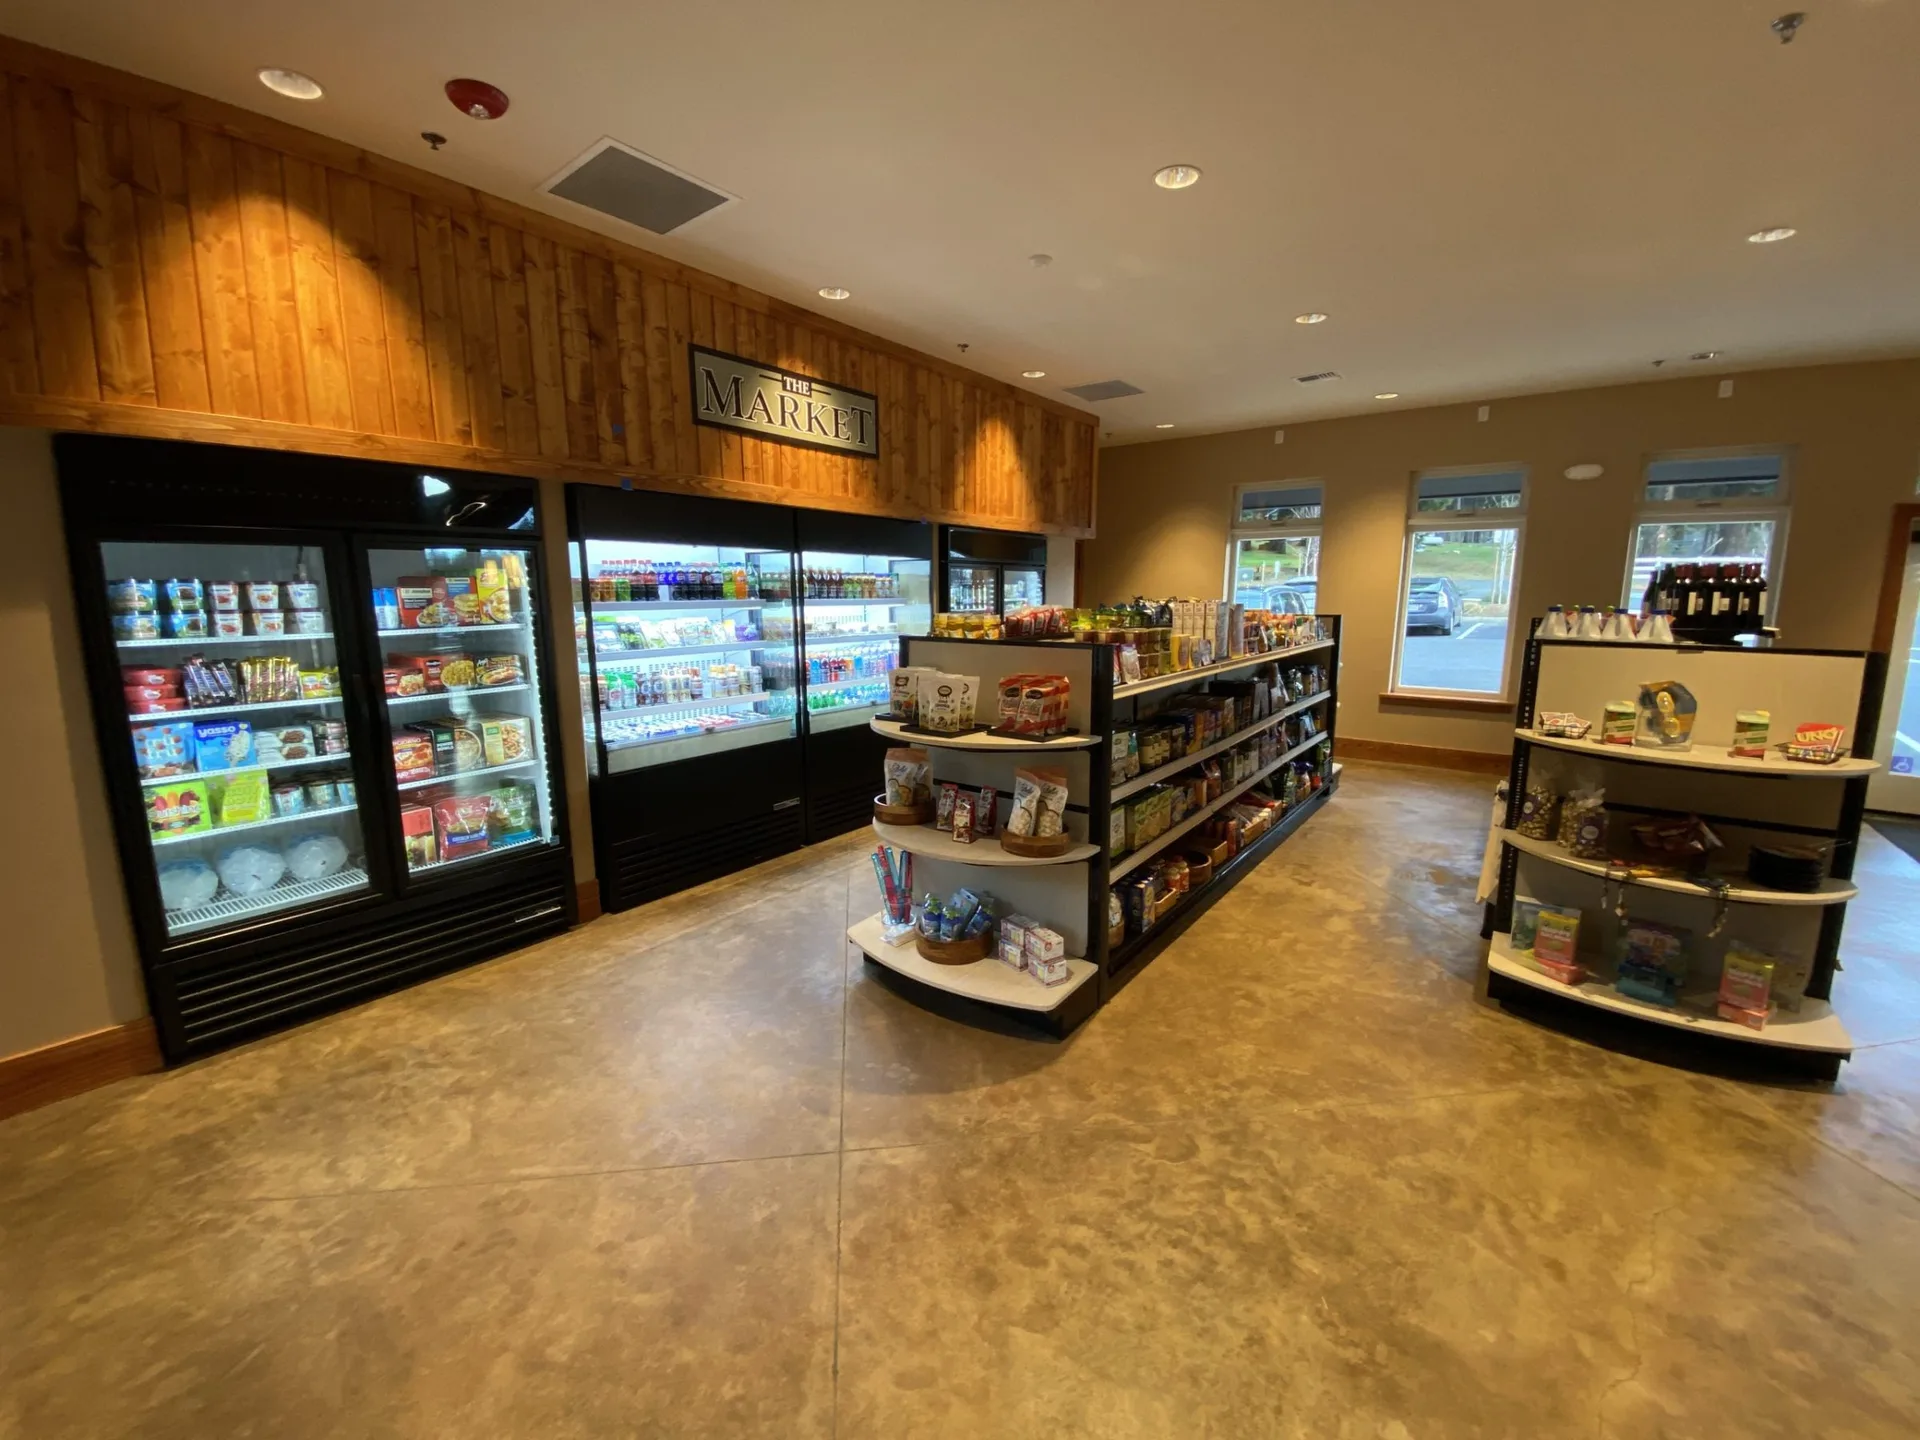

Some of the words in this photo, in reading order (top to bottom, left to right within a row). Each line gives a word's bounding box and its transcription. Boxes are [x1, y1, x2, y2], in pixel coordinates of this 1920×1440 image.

[783, 375, 811, 396] THE
[700, 366, 873, 447] MARKET
[197, 725, 237, 738] yasso
[1795, 726, 1839, 743] UNO
